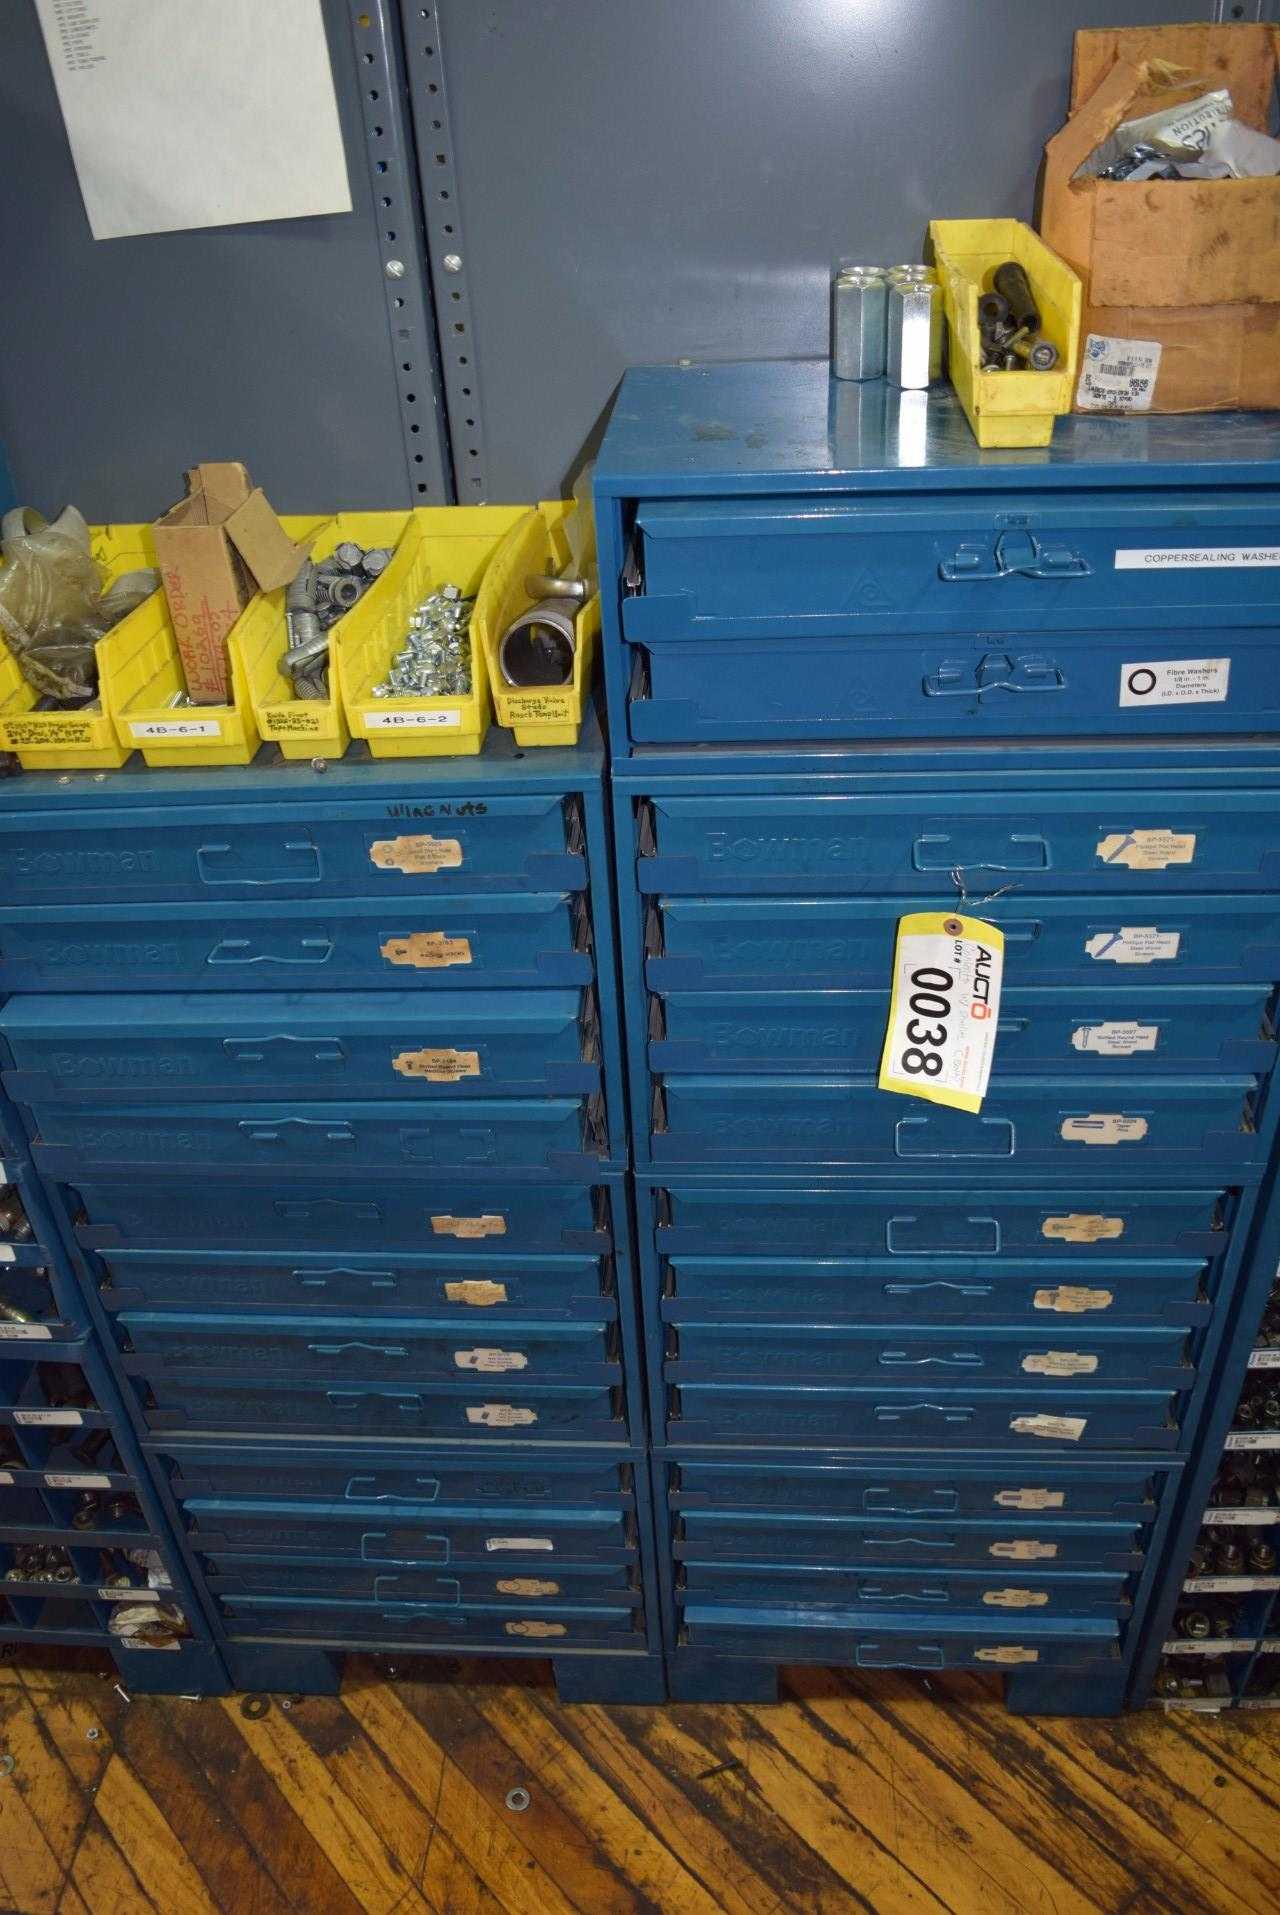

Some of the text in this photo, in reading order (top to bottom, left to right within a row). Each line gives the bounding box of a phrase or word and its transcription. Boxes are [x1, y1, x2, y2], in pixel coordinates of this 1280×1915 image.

[1144, 551, 1280, 564] COPPERSEALING WASHE
[1187, 667, 1218, 675] Washers
[382, 715, 448, 726] 4B-6-2
[146, 724, 207, 735] 4B-6-1
[902, 967, 954, 1077] 0038
